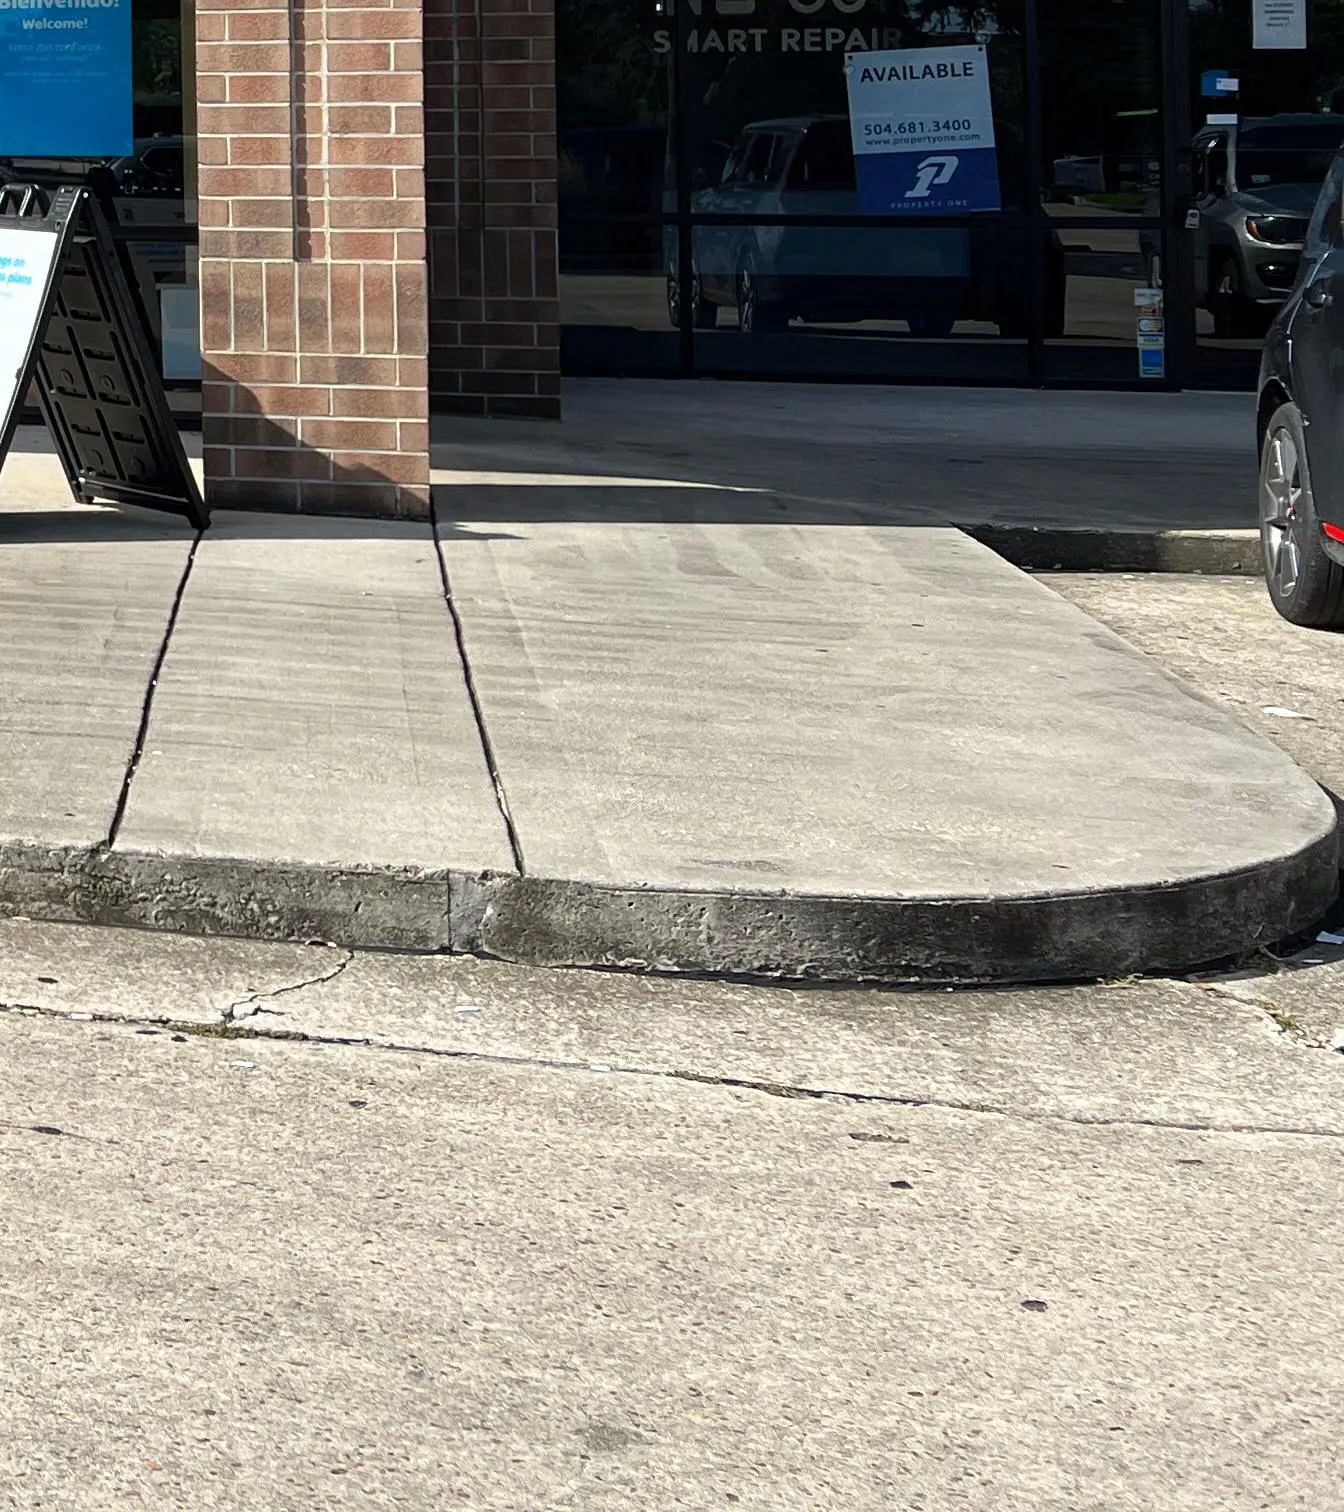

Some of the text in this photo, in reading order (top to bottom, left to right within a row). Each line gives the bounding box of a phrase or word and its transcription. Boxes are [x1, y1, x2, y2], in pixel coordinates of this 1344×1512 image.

[22, 18, 89, 30] Welcome!
[781, 28, 903, 53] REPAIR
[860, 61, 974, 83] AVAILABLE
[864, 119, 971, 136] 504.681.3400
[864, 133, 981, 148] www.propertyone.com
